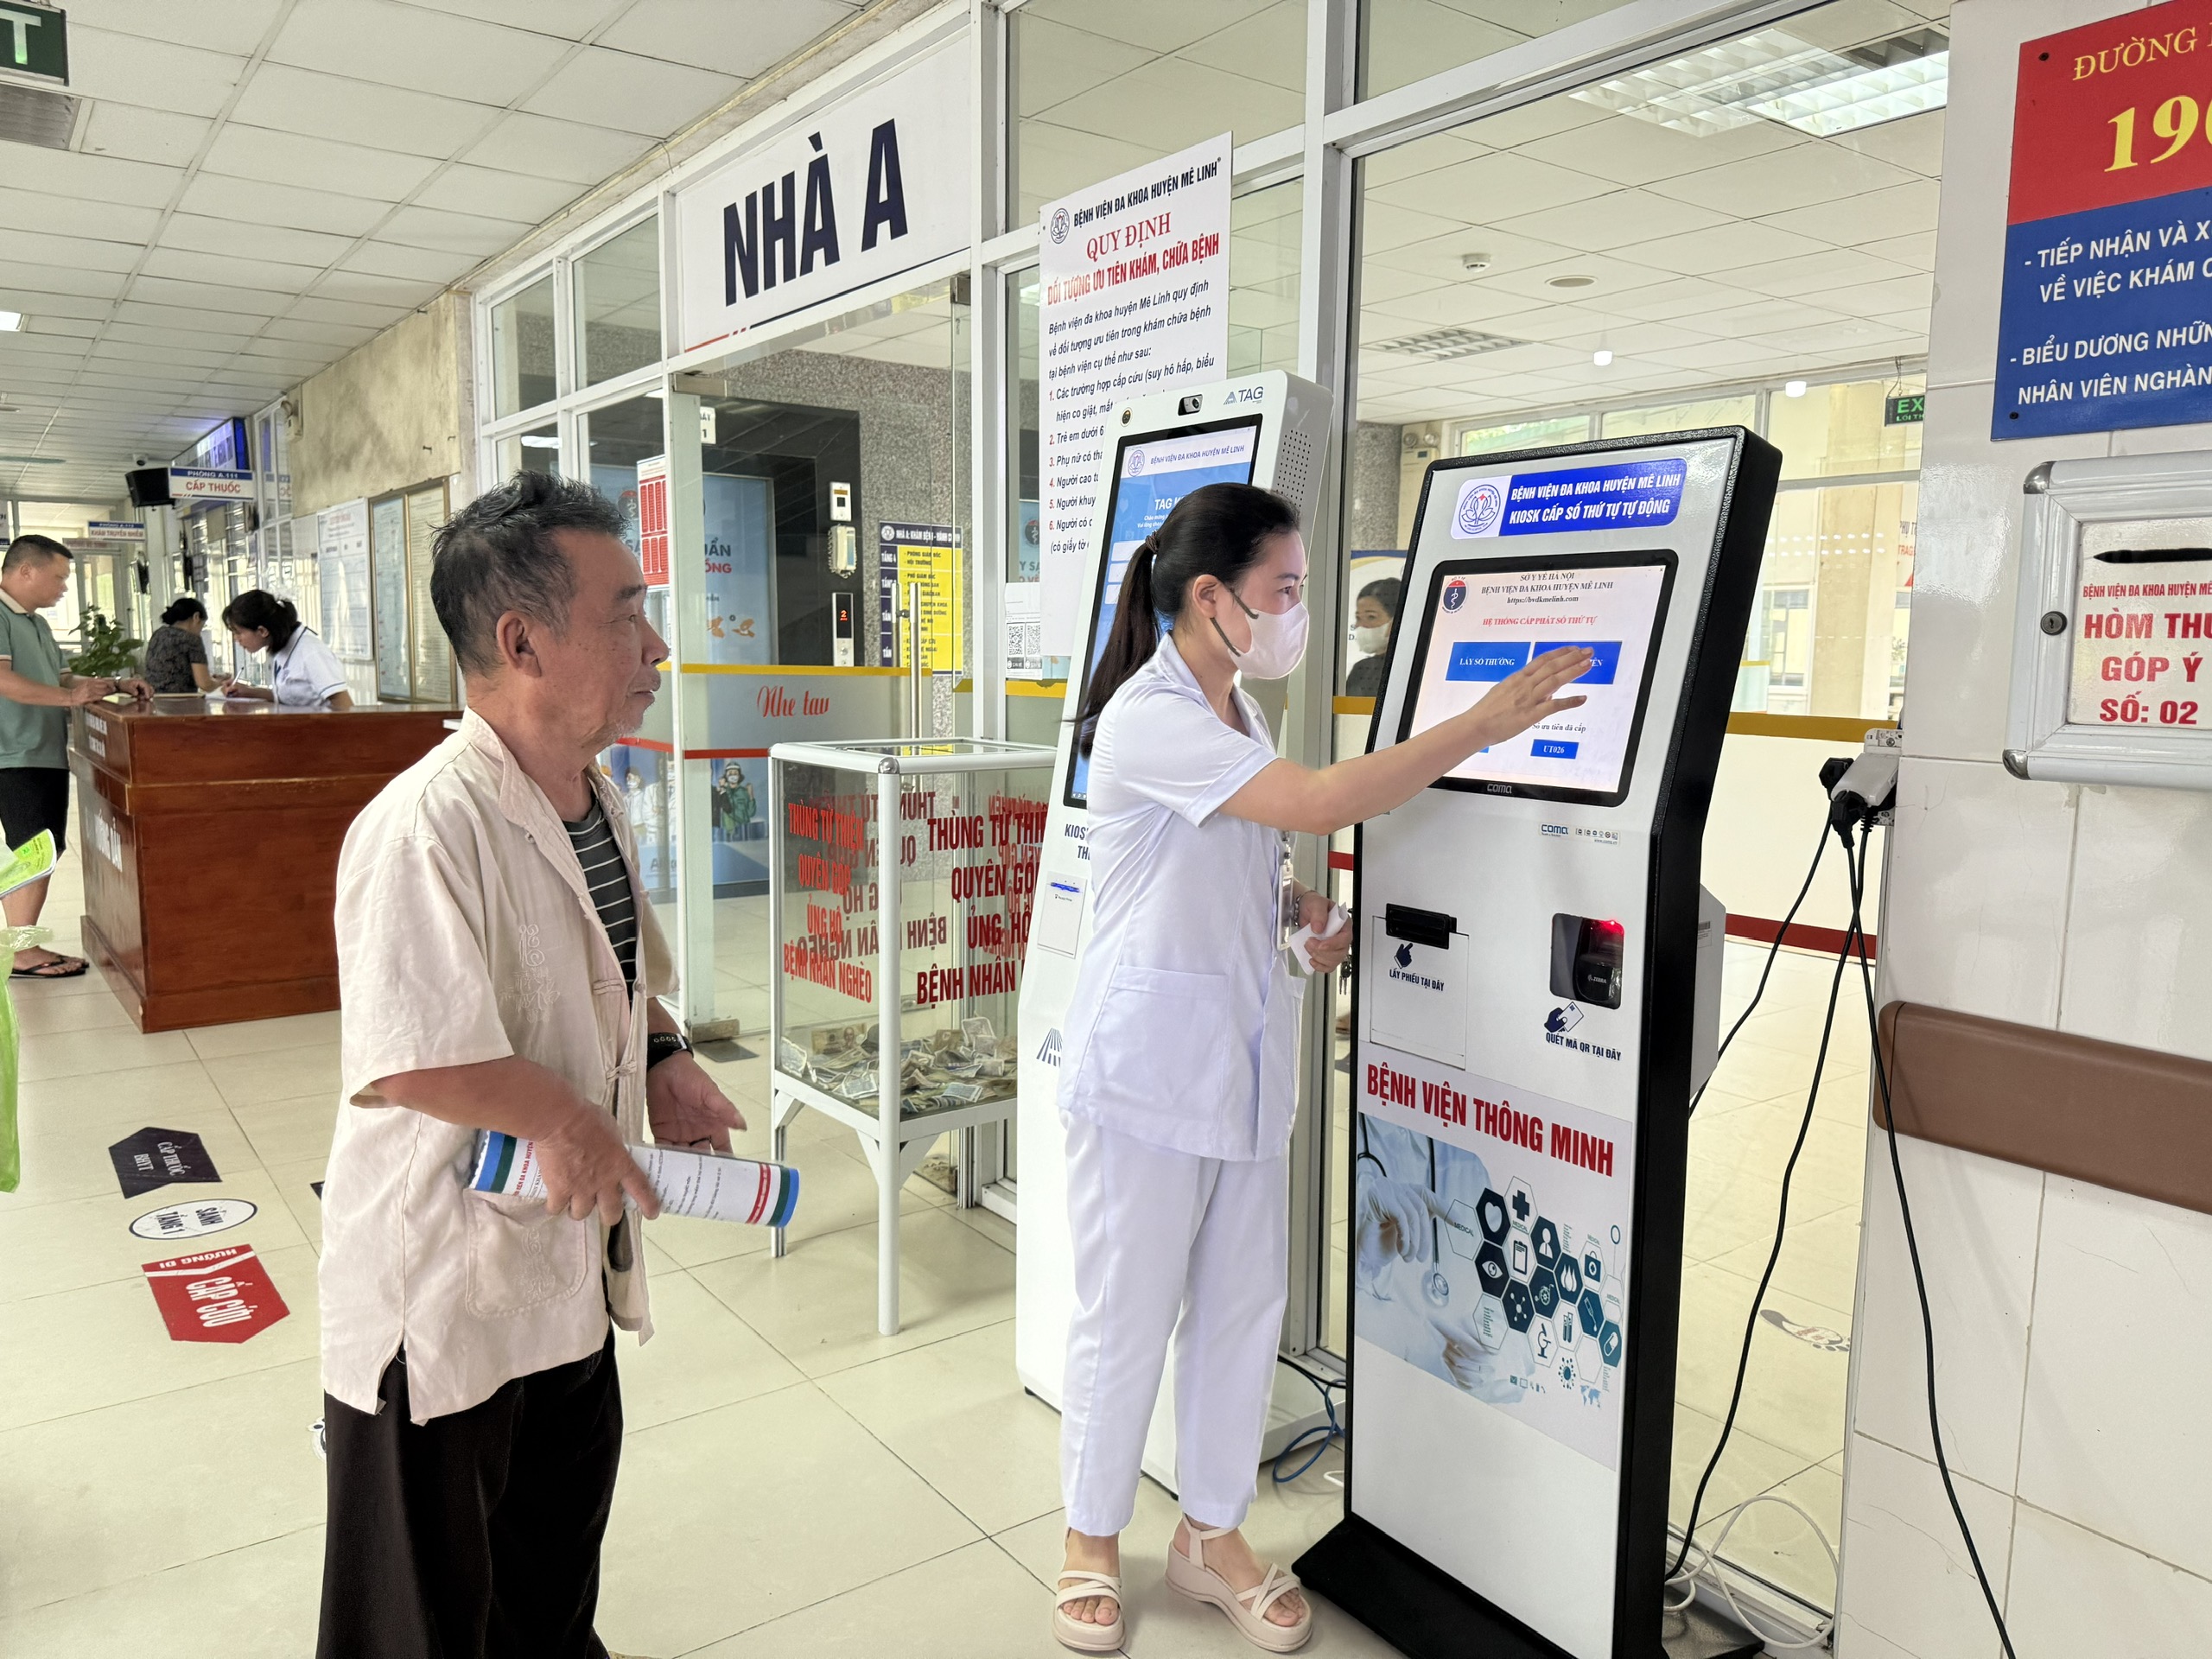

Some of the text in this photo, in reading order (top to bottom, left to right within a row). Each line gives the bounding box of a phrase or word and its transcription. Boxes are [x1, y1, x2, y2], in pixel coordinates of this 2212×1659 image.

[2072, 27, 2198, 80] ĐƯỜNG
[1074, 161, 1217, 228] BỆNH VIỆN ĐA KHOA HUYỆN MÊ LINH
[723, 118, 909, 308] NHÀ A
[1086, 212, 1172, 263] QUY ĐỊNH
[2037, 219, 2188, 268] TIẾP NHẬN VÀ
[1107, 232, 1219, 287] TIÊN KHÁM, CHỮA BỆNH
[2040, 258, 2195, 303] VỀ VIỆC KHÁM
[1049, 279, 1209, 335] Bệnh viện đa khoa huyện Mê Linh quy định
[1105, 304, 1211, 343] tiên trong khám bệnh
[2022, 334, 2069, 365] BIỂU
[2074, 332, 2149, 359] DƯƠNG
[1058, 351, 1134, 378] bệnh viện cụ như
[1056, 372, 1127, 400] Các trường hợp cấp
[1238, 386, 1263, 403] TAG
[2018, 372, 2127, 405] NHÂN VIÊN
[1056, 409, 1071, 423] hiện
[1069, 432, 1079, 442] em
[1056, 456, 1070, 469] Phụ
[1185, 451, 1201, 460] KHOA
[1230, 445, 1245, 454] LINH
[186, 479, 241, 494] CẤP THUỐC
[1056, 474, 1090, 489] Người cao
[1510, 486, 1535, 502] BỆNH
[1537, 483, 1559, 500] VIỆN
[1560, 483, 1573, 497] ĐA
[1574, 480, 1601, 495] KHOA
[1602, 475, 1634, 493] HUYỆN
[1637, 474, 1654, 489] MÊ
[1656, 474, 1681, 487] LINH
[1056, 497, 1078, 511] Người
[1154, 499, 1173, 511] TAG
[1509, 497, 1671, 524] KIOSK CẤP SỐ THỨ TỰ TỰ ĐỘNG
[1056, 518, 1077, 531] Người
[1481, 586, 1500, 595] BỆNH
[1502, 585, 1518, 594] VIỆN
[1553, 583, 1580, 593] HUYỆN
[1580, 580, 1592, 589] MÊ
[2083, 583, 2105, 600] BỆNH
[2107, 582, 2126, 600] VIỆN
[2128, 584, 2140, 596] ĐA
[2142, 583, 2164, 596] KHOA
[2167, 581, 2196, 598] HUYỆN
[1483, 618, 1495, 626] HỆ
[2084, 607, 2153, 639] HÒM
[1485, 657, 1515, 666] THƯỜNG
[2101, 651, 2203, 683] GÓP Ý
[2099, 691, 2198, 725] SỐ: 02
[1574, 723, 1586, 734] cấp
[1543, 745, 1565, 754] UT026
[788, 799, 819, 841] THÙNG
[835, 810, 864, 855] THIỆN
[927, 810, 984, 852] THÙNG
[989, 805, 1012, 847] TỪ
[798, 852, 830, 893] QUYÊN
[951, 858, 1007, 903] QUYÊN
[967, 905, 1001, 950] ỦNG
[838, 961, 872, 1003] NGHÈO
[917, 955, 1015, 1009] BỆNH NHÂN
[1389, 968, 1445, 991] LẤY PHIẾU TẠI ĐÂY
[1566, 1038, 1621, 1061] MÃ QR TẠI ĐÂY
[1367, 1061, 1614, 1178] BỆNH VIỆN THÔNG MINH
[181, 1248, 238, 1265] HƯỚNG
[186, 1276, 257, 1328] CẤP CỨU
